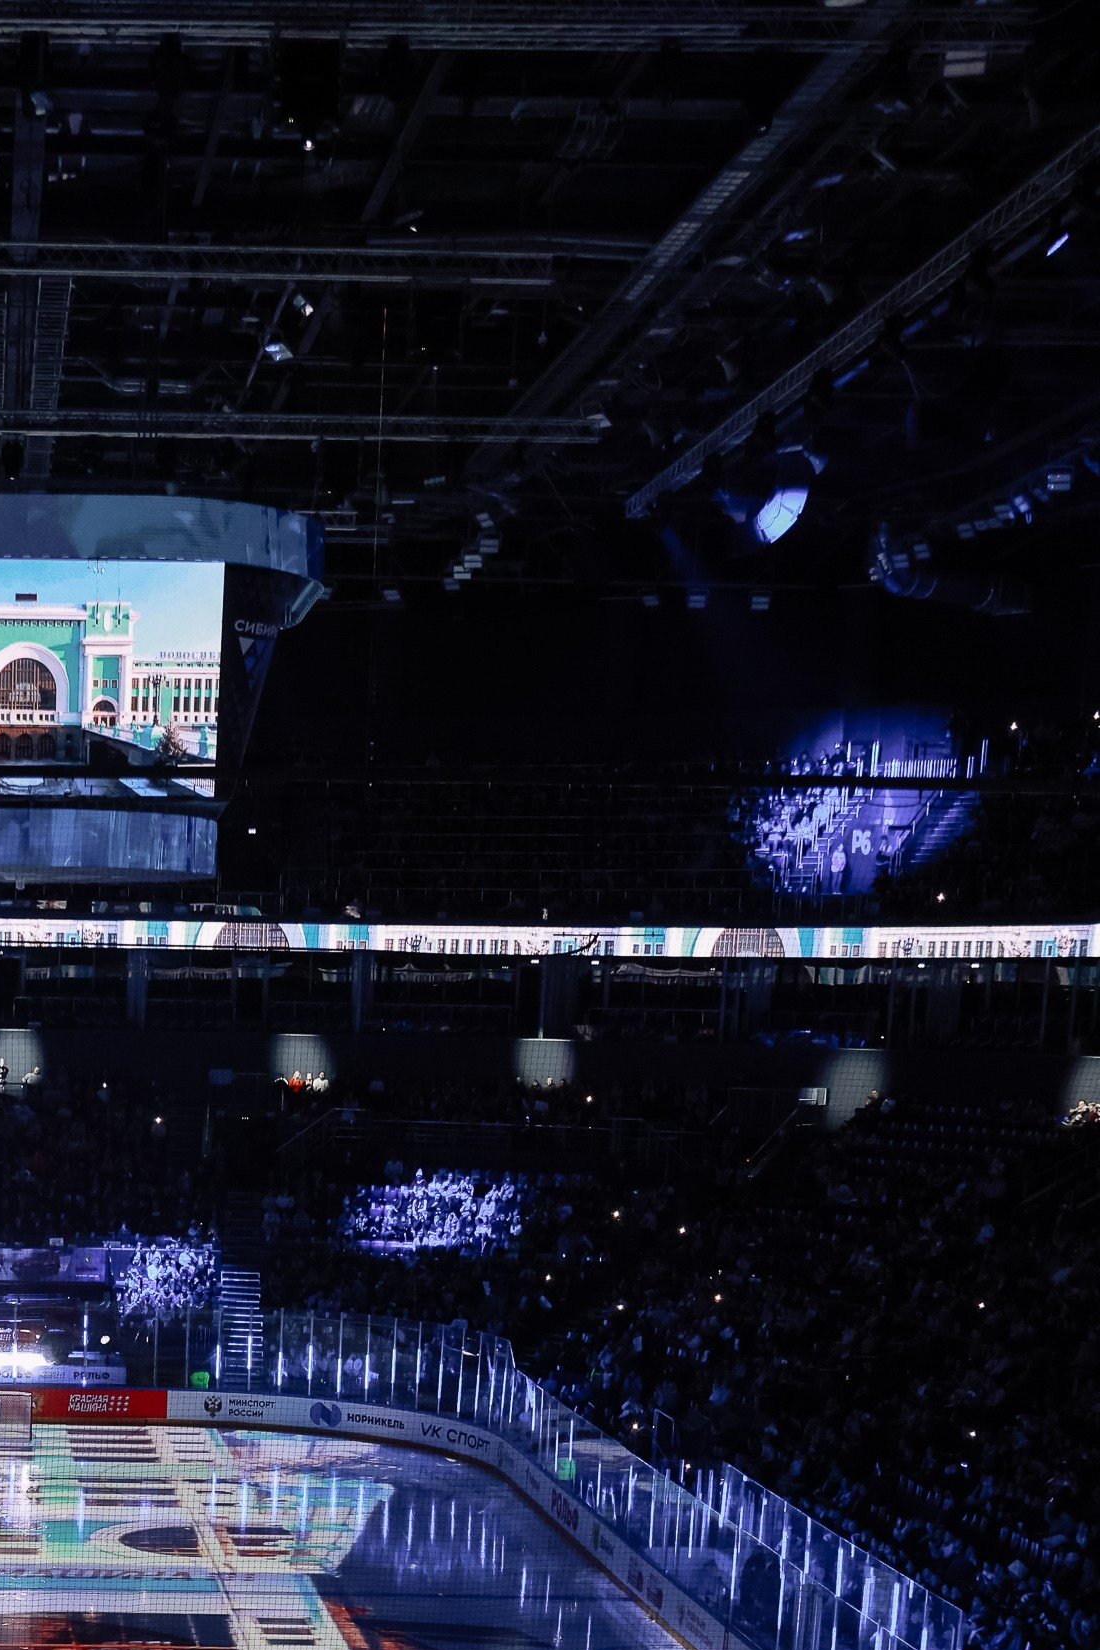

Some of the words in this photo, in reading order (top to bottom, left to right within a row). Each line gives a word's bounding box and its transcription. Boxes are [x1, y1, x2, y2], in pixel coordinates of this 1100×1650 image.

[73, 1371, 110, 1380] РОЛЬФ
[69, 1394, 109, 1403] КРАСНАЯ
[68, 1402, 108, 1412] МАШИНА
[229, 1399, 276, 1409] МИНСПОРТ
[228, 1408, 264, 1418] РОССИИ
[347, 1412, 405, 1430] НОРНИКЕЛЬ
[421, 1422, 441, 1439] VK
[447, 1429, 490, 1453] СПОРТ
